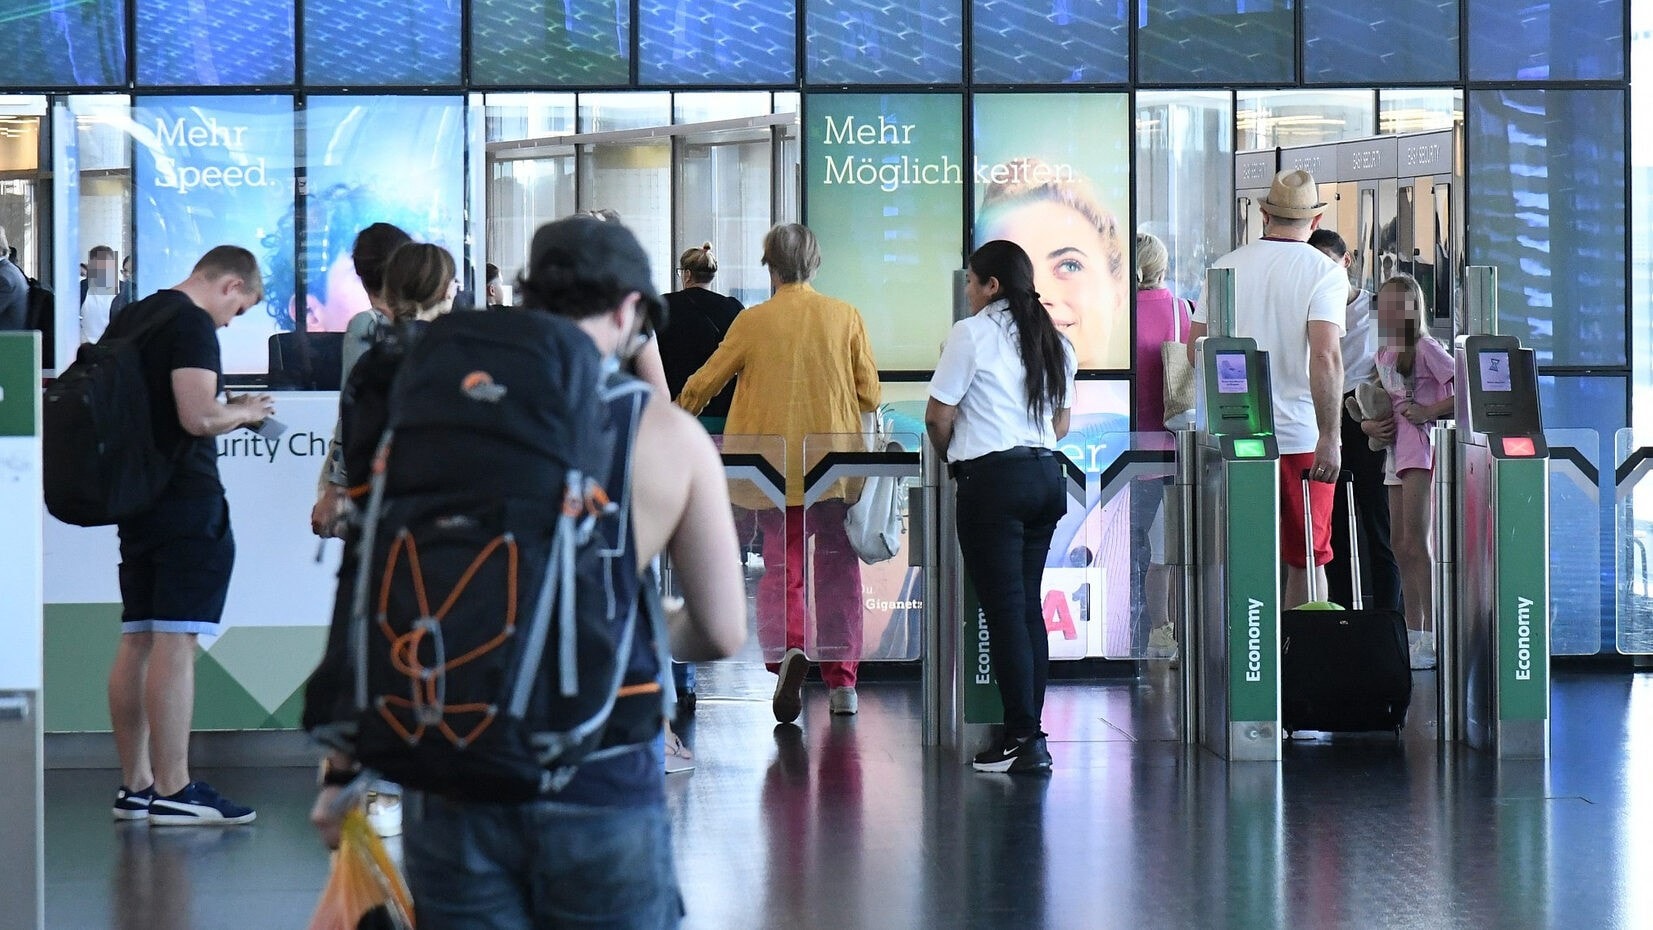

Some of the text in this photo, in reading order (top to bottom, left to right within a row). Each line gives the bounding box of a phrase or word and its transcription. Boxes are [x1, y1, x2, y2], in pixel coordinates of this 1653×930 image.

[156, 117, 248, 147] Mehr
[823, 115, 916, 145] Mehr
[154, 157, 276, 194] Speed.
[289, 431, 332, 457] Ch
[1246, 597, 1264, 682] Economy
[1515, 596, 1534, 681] Economy
